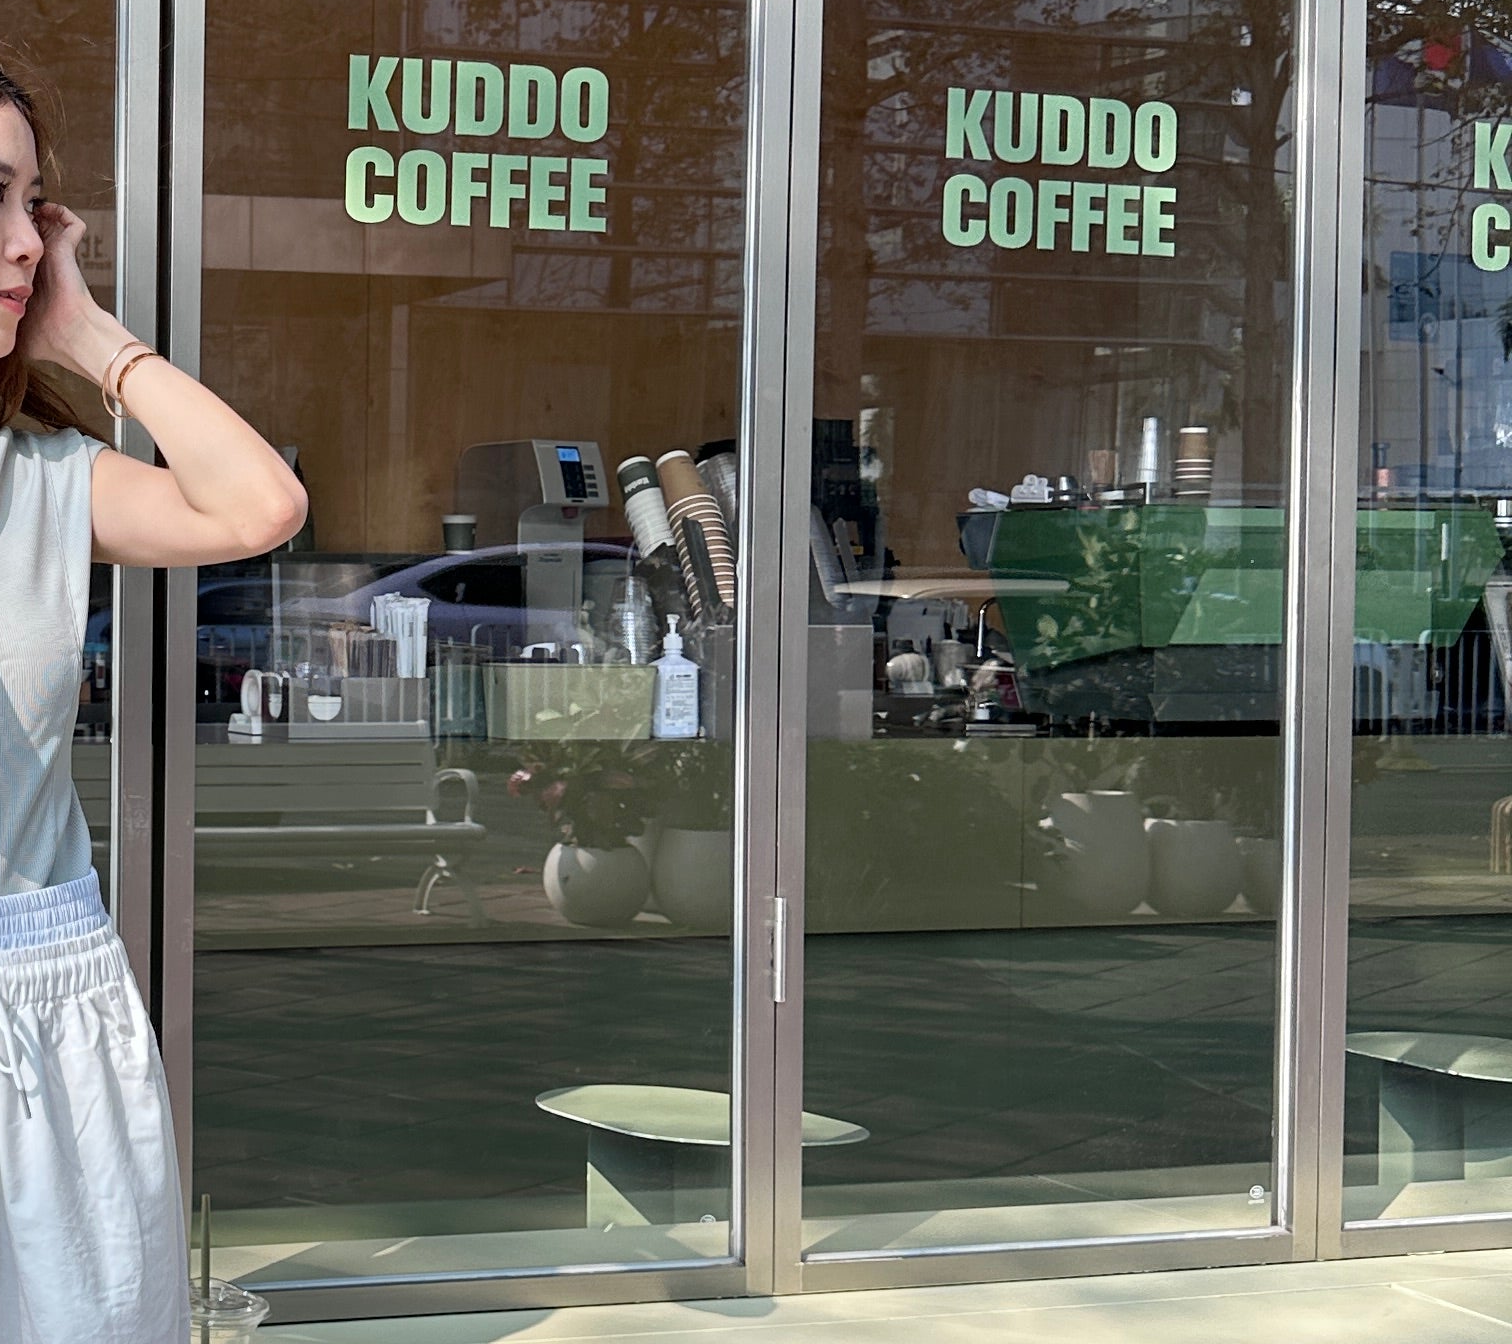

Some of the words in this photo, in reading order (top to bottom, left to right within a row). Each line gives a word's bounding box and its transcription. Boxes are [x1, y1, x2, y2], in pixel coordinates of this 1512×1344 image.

[347, 54, 609, 144] KUDDO
[945, 87, 1178, 174] KUDDO
[344, 146, 608, 233] COFFEE
[942, 174, 1177, 259] COFFEE
